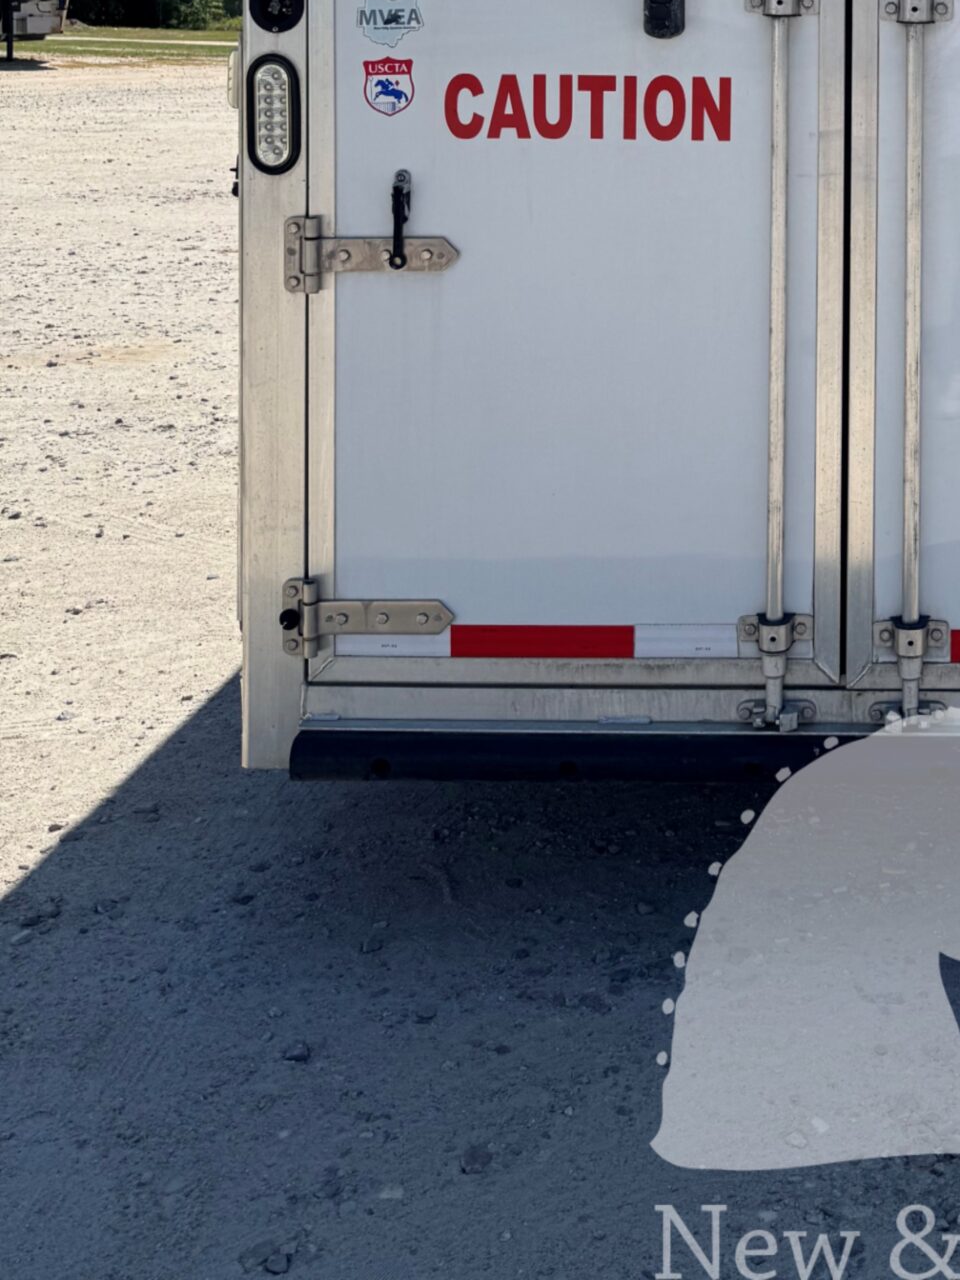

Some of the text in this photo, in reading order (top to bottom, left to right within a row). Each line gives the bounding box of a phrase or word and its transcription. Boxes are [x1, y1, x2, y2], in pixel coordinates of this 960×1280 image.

[359, 8, 421, 26] MVEA
[368, 63, 408, 74] USCTA
[444, 73, 732, 142] CAUTION
